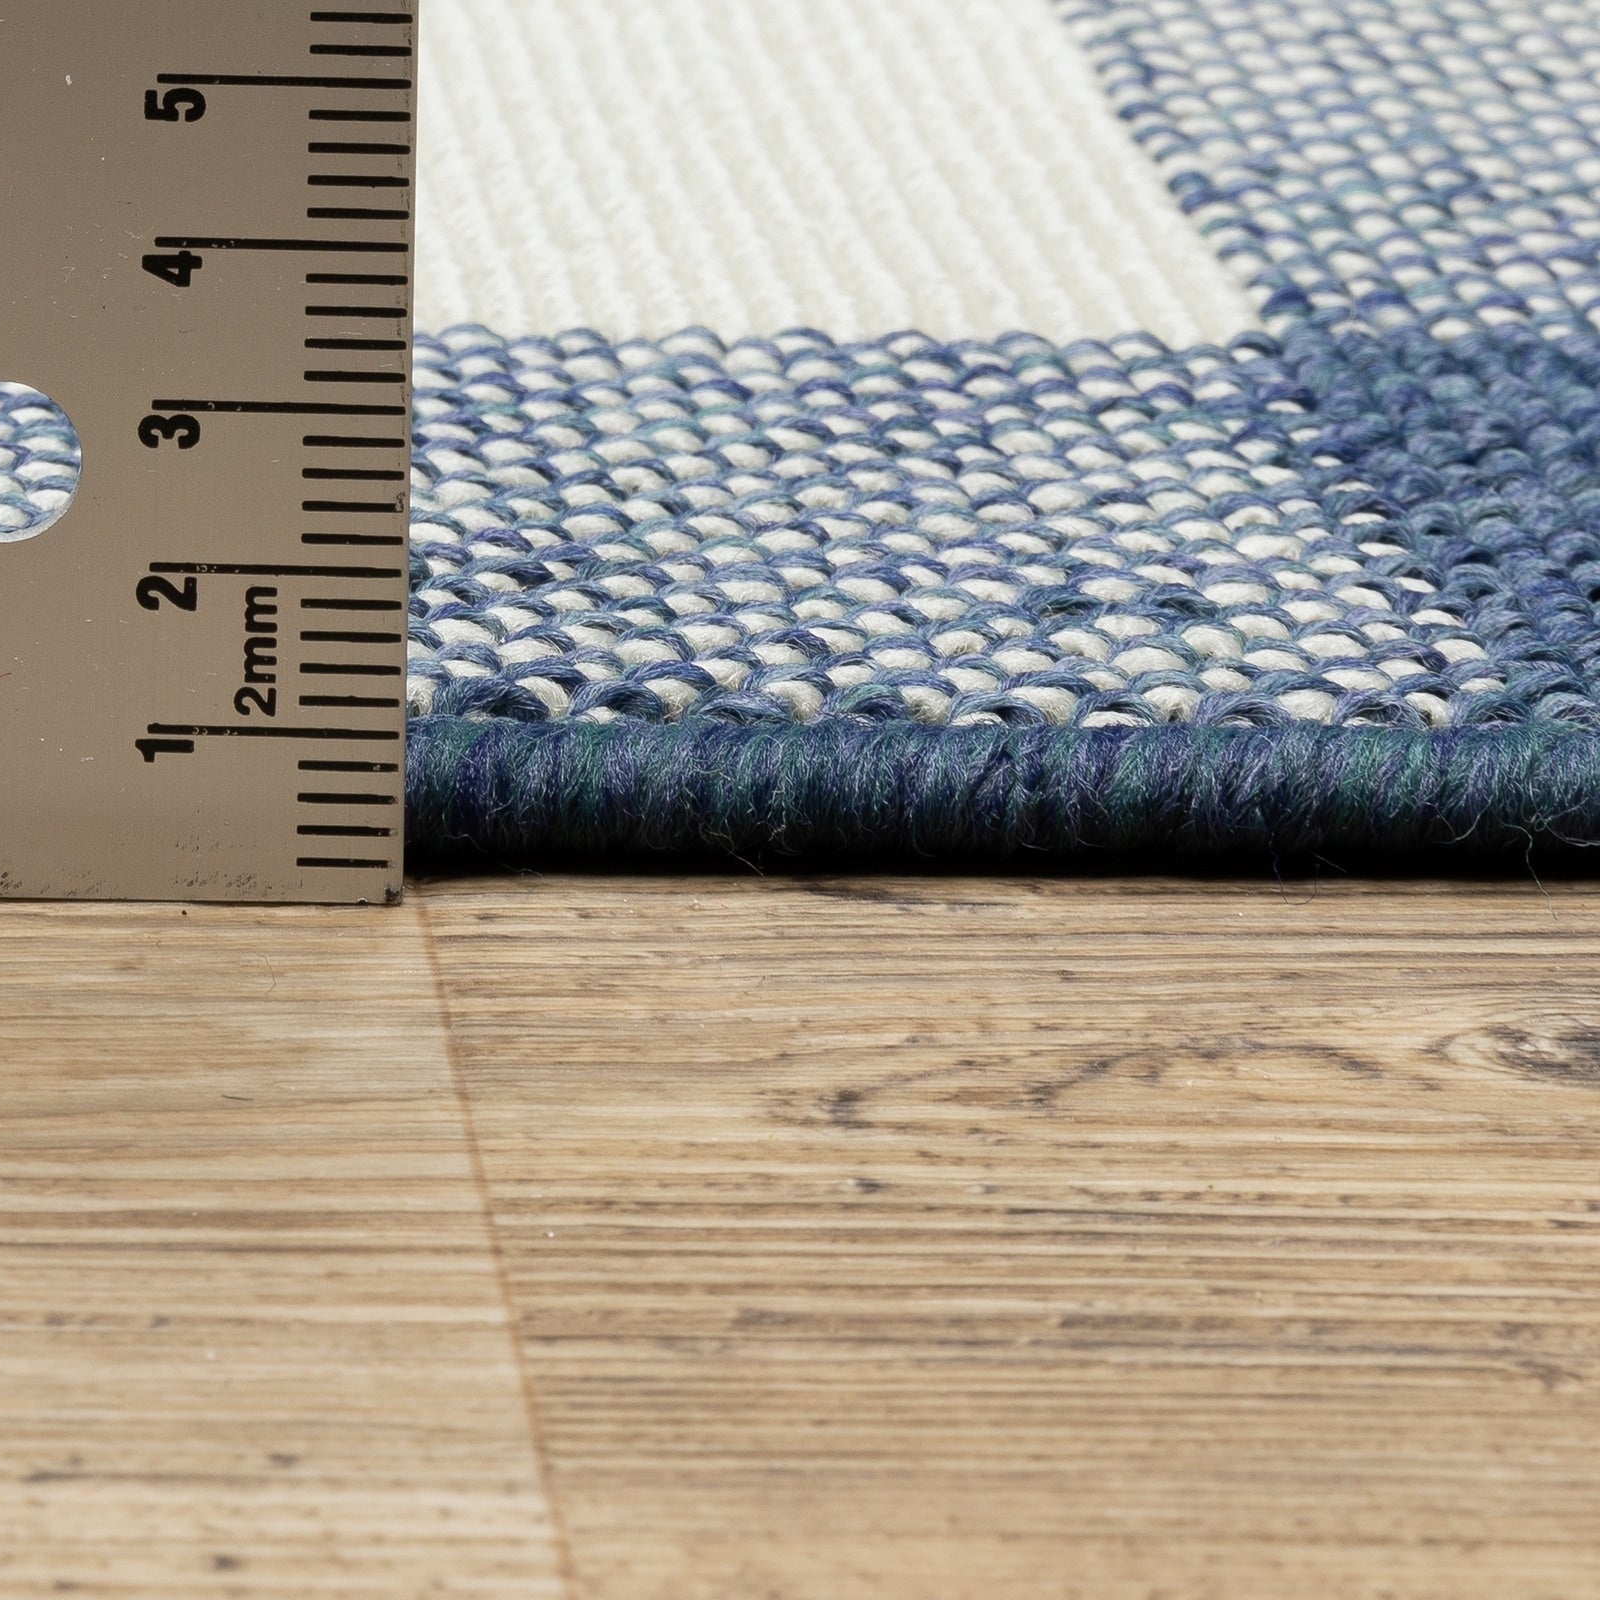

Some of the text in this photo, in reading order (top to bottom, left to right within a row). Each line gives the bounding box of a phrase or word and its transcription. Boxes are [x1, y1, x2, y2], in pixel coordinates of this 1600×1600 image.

[143, 88, 207, 123] 5
[141, 251, 203, 288] 4
[137, 414, 201, 450] 3
[135, 576, 198, 612] 2
[233, 586, 278, 717] 2mm
[134, 739, 195, 763] 1
